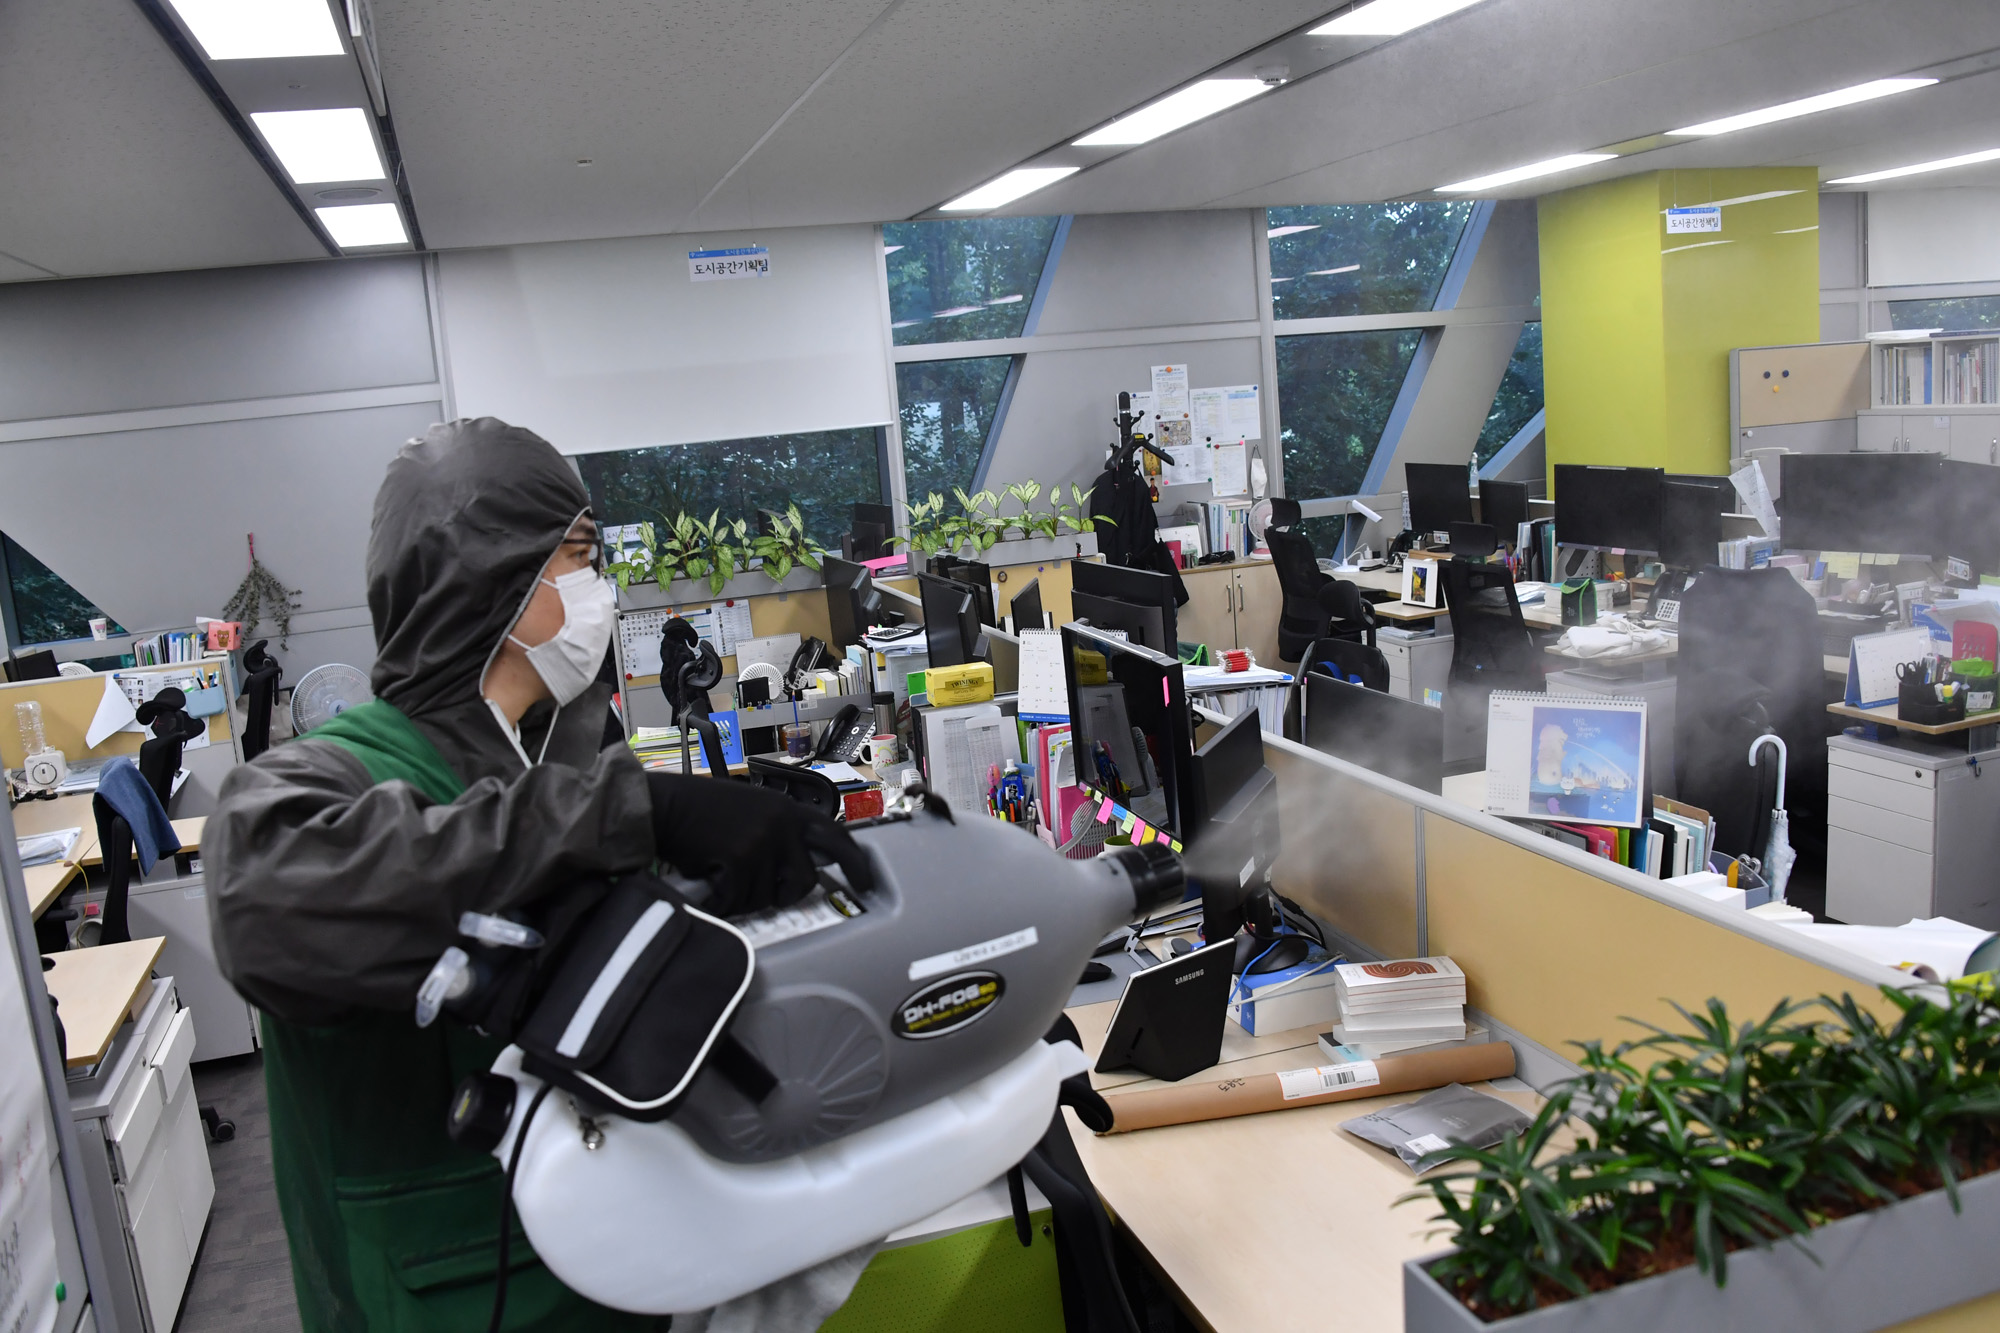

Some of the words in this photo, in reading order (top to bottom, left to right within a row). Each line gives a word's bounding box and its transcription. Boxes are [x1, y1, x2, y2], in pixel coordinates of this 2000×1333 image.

[1671, 217, 1719, 229] 도시공간정책팀
[694, 258, 768, 275] 도시공간기획팀
[952, 679, 979, 688] TWININGS
[1175, 968, 1205, 985] SAMSUNG
